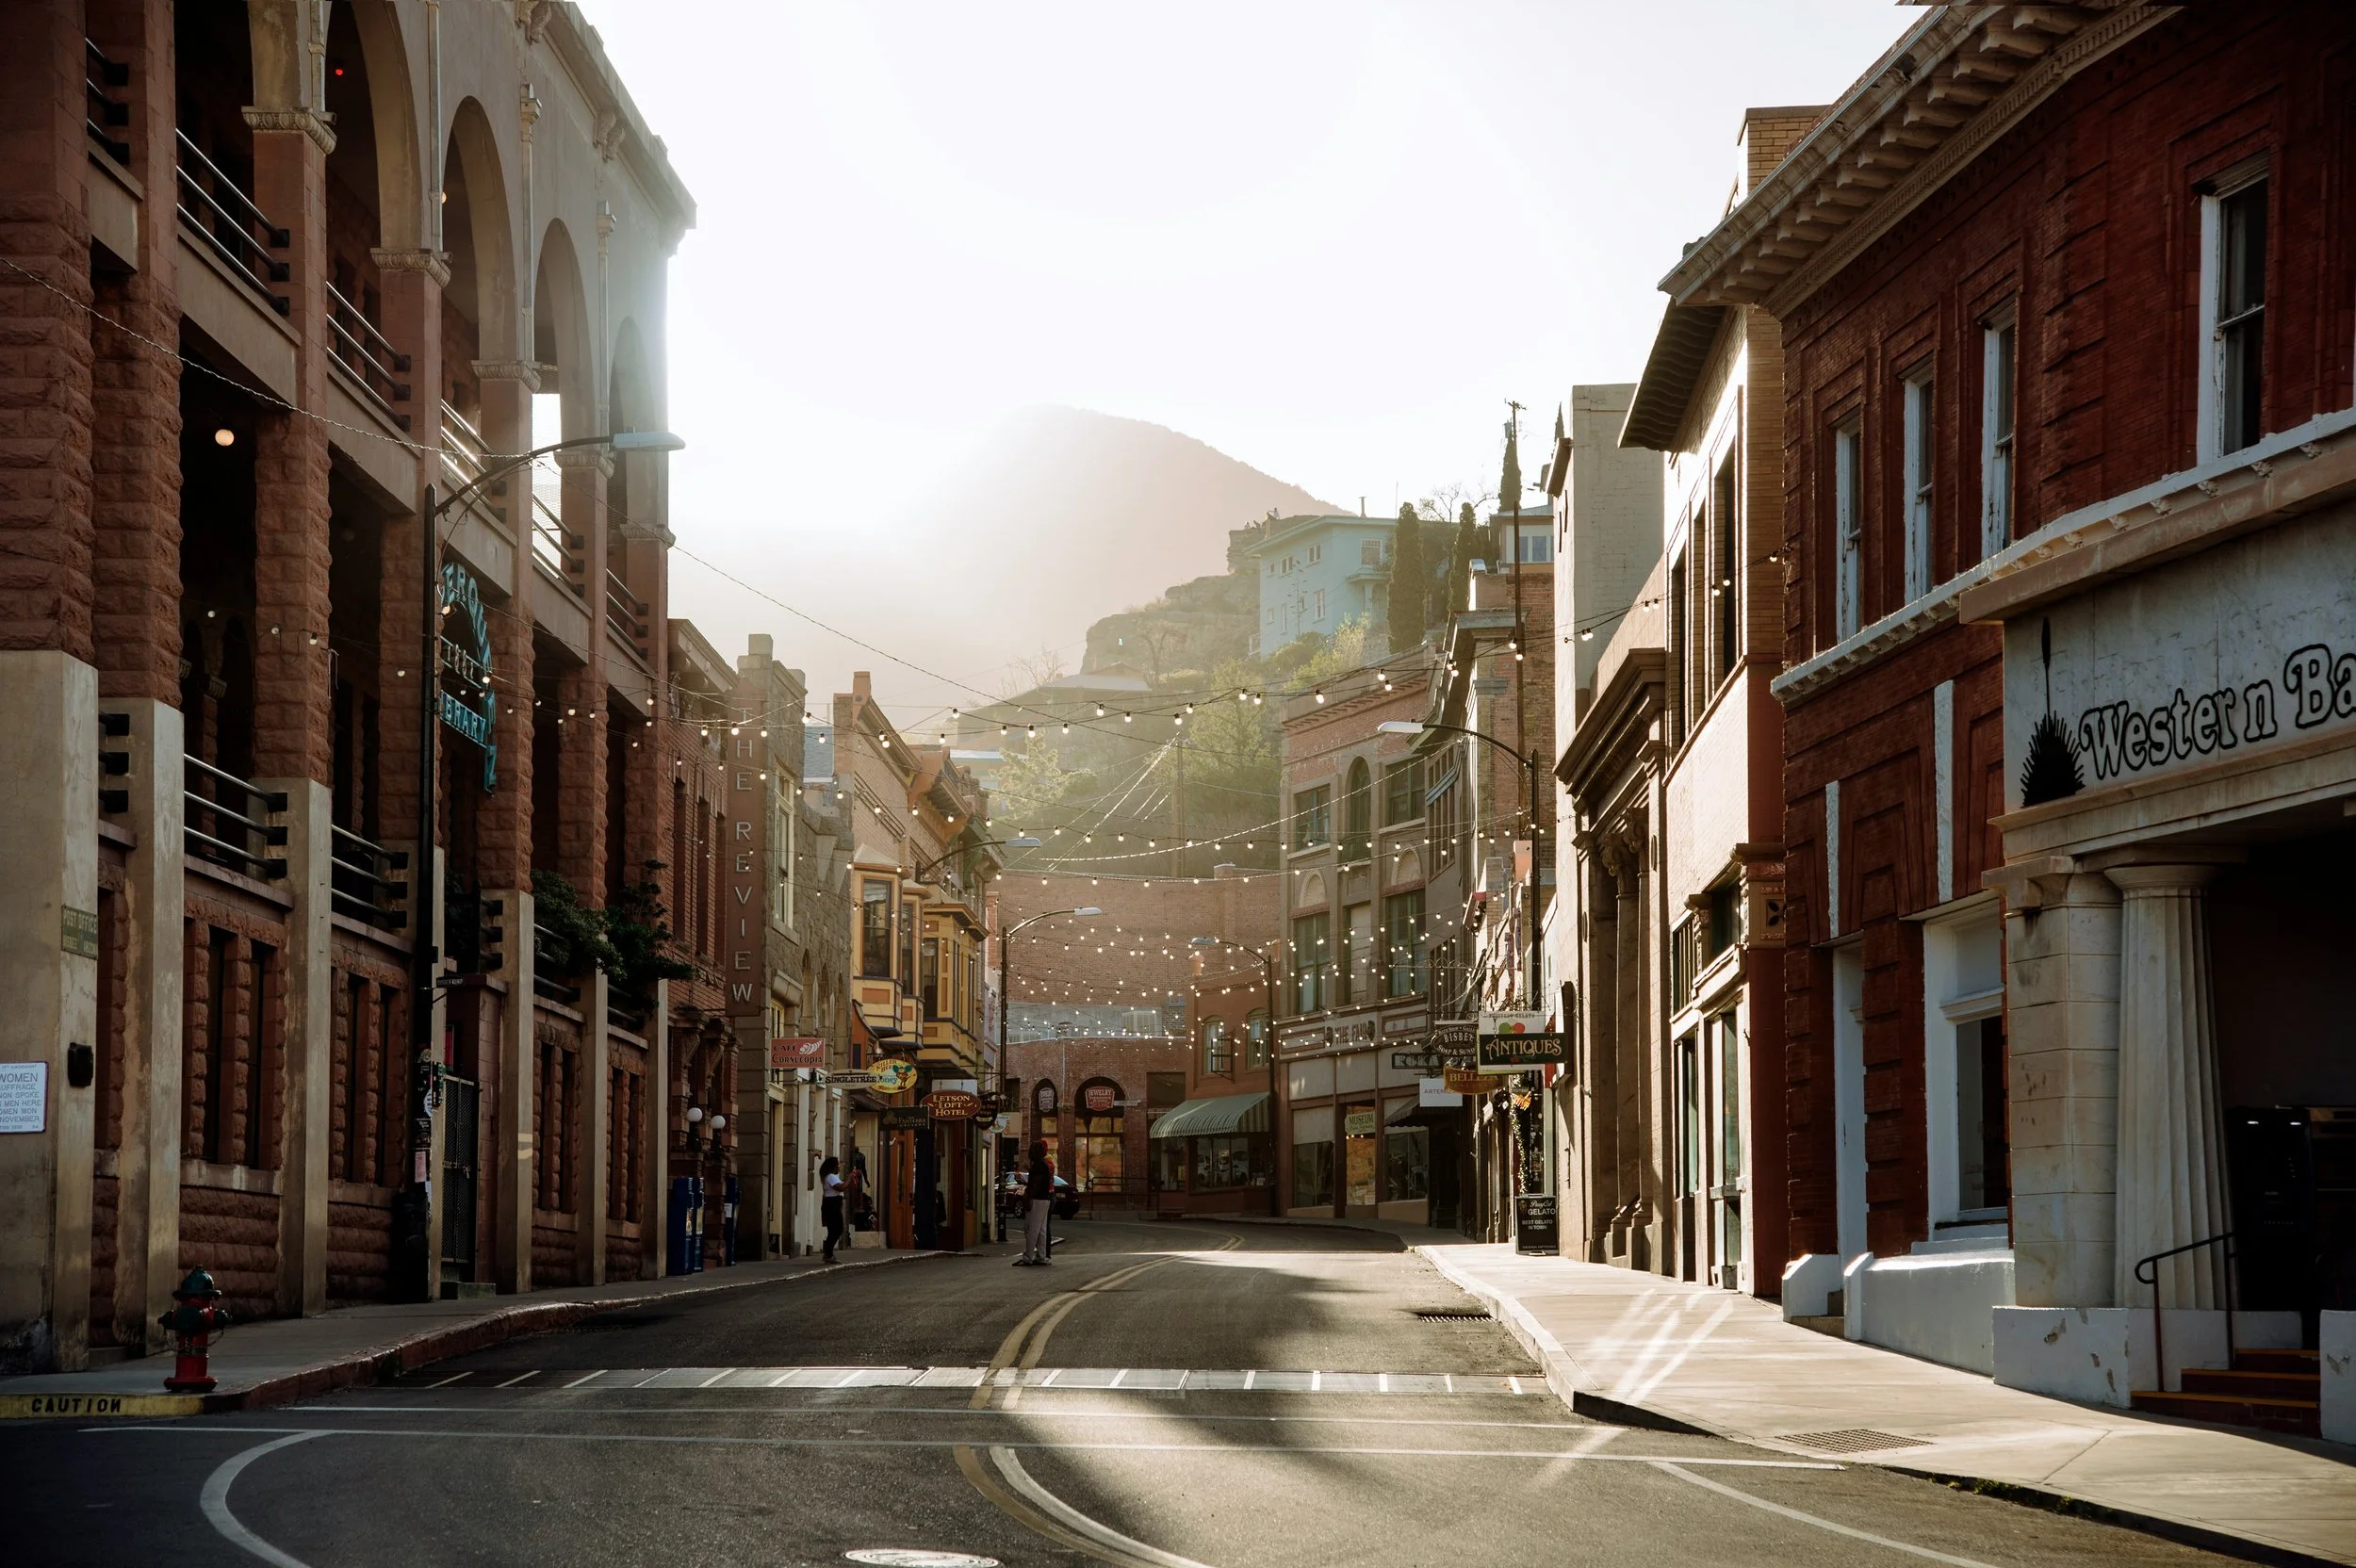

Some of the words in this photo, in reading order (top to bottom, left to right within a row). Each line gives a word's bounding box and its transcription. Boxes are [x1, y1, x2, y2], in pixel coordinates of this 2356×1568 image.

[2079, 678, 2277, 780] Western
[736, 708, 752, 791] THE
[731, 821, 754, 1002] REVIEW
[1334, 1024, 1349, 1044] THE
[1443, 1032, 1474, 1043] BISBEE
[1437, 1044, 1452, 1055] SOAP
[1485, 1038, 1562, 1060] ANTIQUES
[772, 1053, 822, 1064] CORNUCOPIA
[0, 1072, 39, 1083] WOMEN
[826, 1075, 876, 1084] SINGLETREE
[932, 1094, 971, 1102] LETSON
[935, 1108, 968, 1117] HOTEL
[1349, 1113, 1374, 1125] MUSEUM
[31, 1397, 122, 1413] CAUTION
